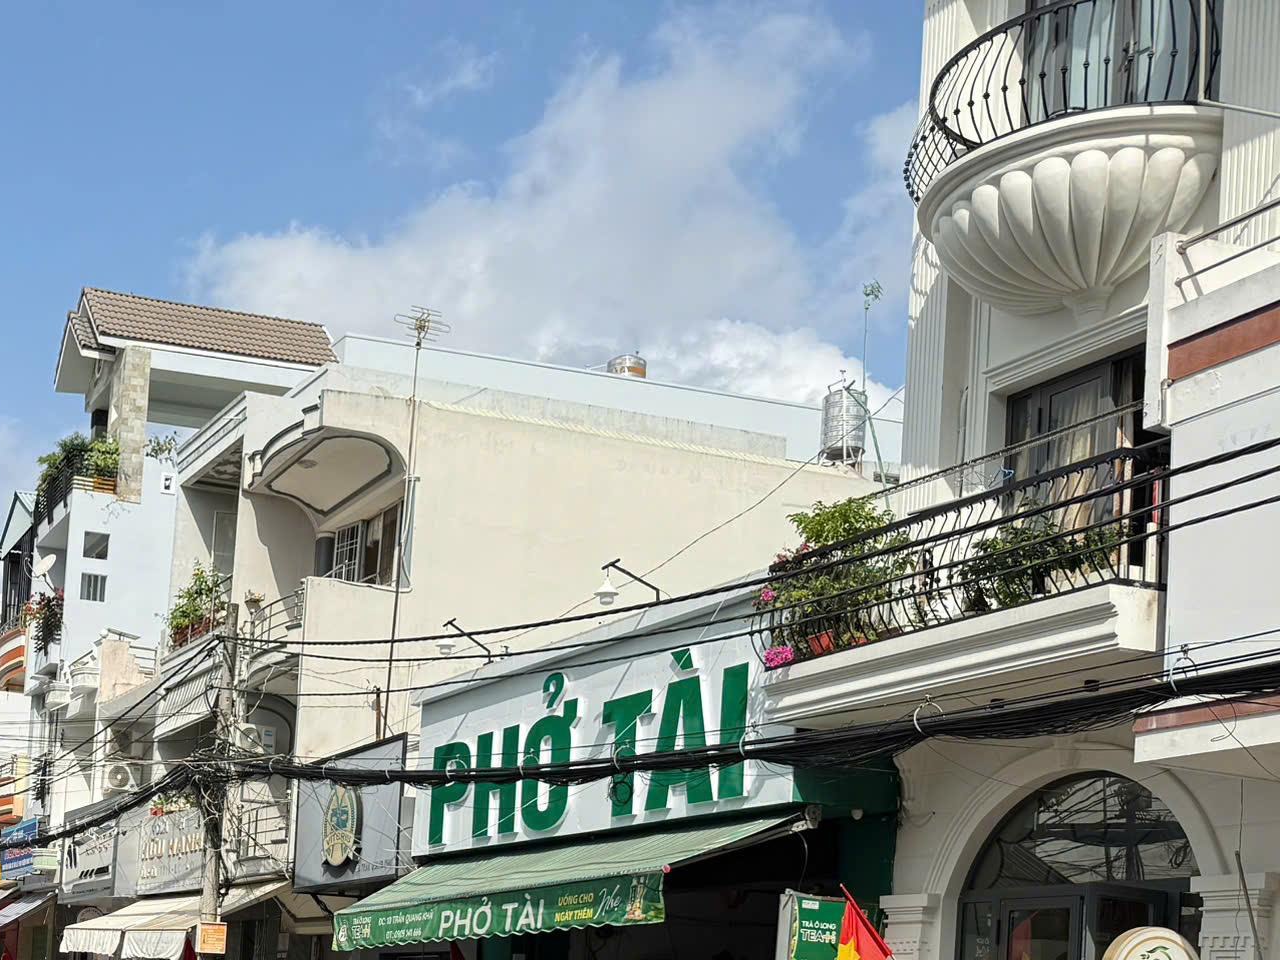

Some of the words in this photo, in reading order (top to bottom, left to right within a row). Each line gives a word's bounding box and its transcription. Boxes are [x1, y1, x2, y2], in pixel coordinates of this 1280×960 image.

[429, 672, 578, 845] PHỞ
[602, 648, 750, 817] TÀI
[579, 892, 594, 905] CHO
[438, 896, 492, 938] PHỞ
[502, 893, 545, 933] TÀI
[801, 920, 813, 929] TRÀ
[820, 923, 837, 931] LONG
